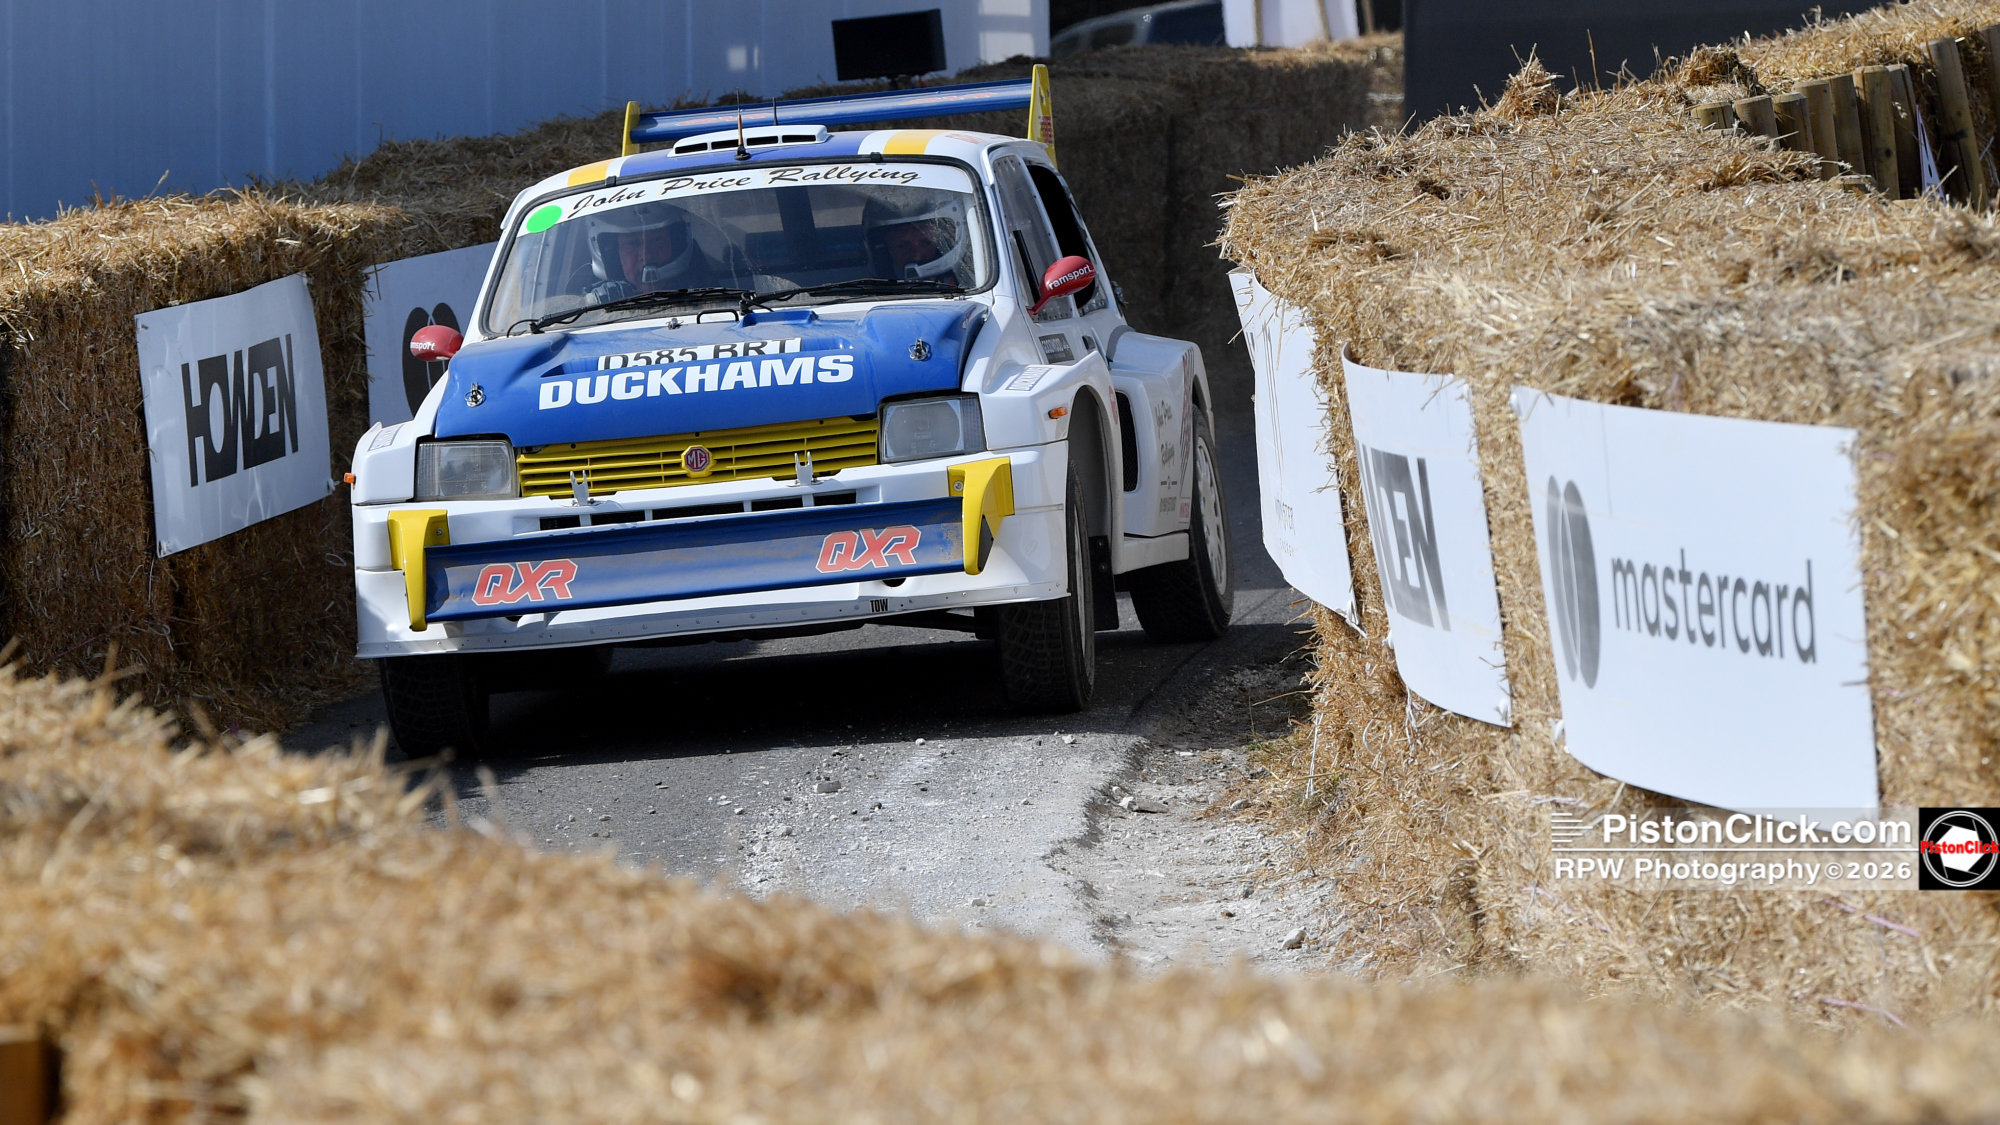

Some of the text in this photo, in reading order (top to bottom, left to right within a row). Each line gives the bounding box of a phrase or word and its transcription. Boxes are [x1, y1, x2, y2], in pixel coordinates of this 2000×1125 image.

[568, 165, 921, 219] John Price Rallying
[1048, 264, 1092, 290] ramsport
[539, 354, 855, 411] DUCKHAMS
[180, 333, 299, 488] HOWDEN
[687, 450, 706, 469] MG
[815, 524, 922, 574] QXR
[472, 558, 579, 606] QXR
[869, 598, 889, 613] TOW
[1611, 548, 1817, 664] mastercard
